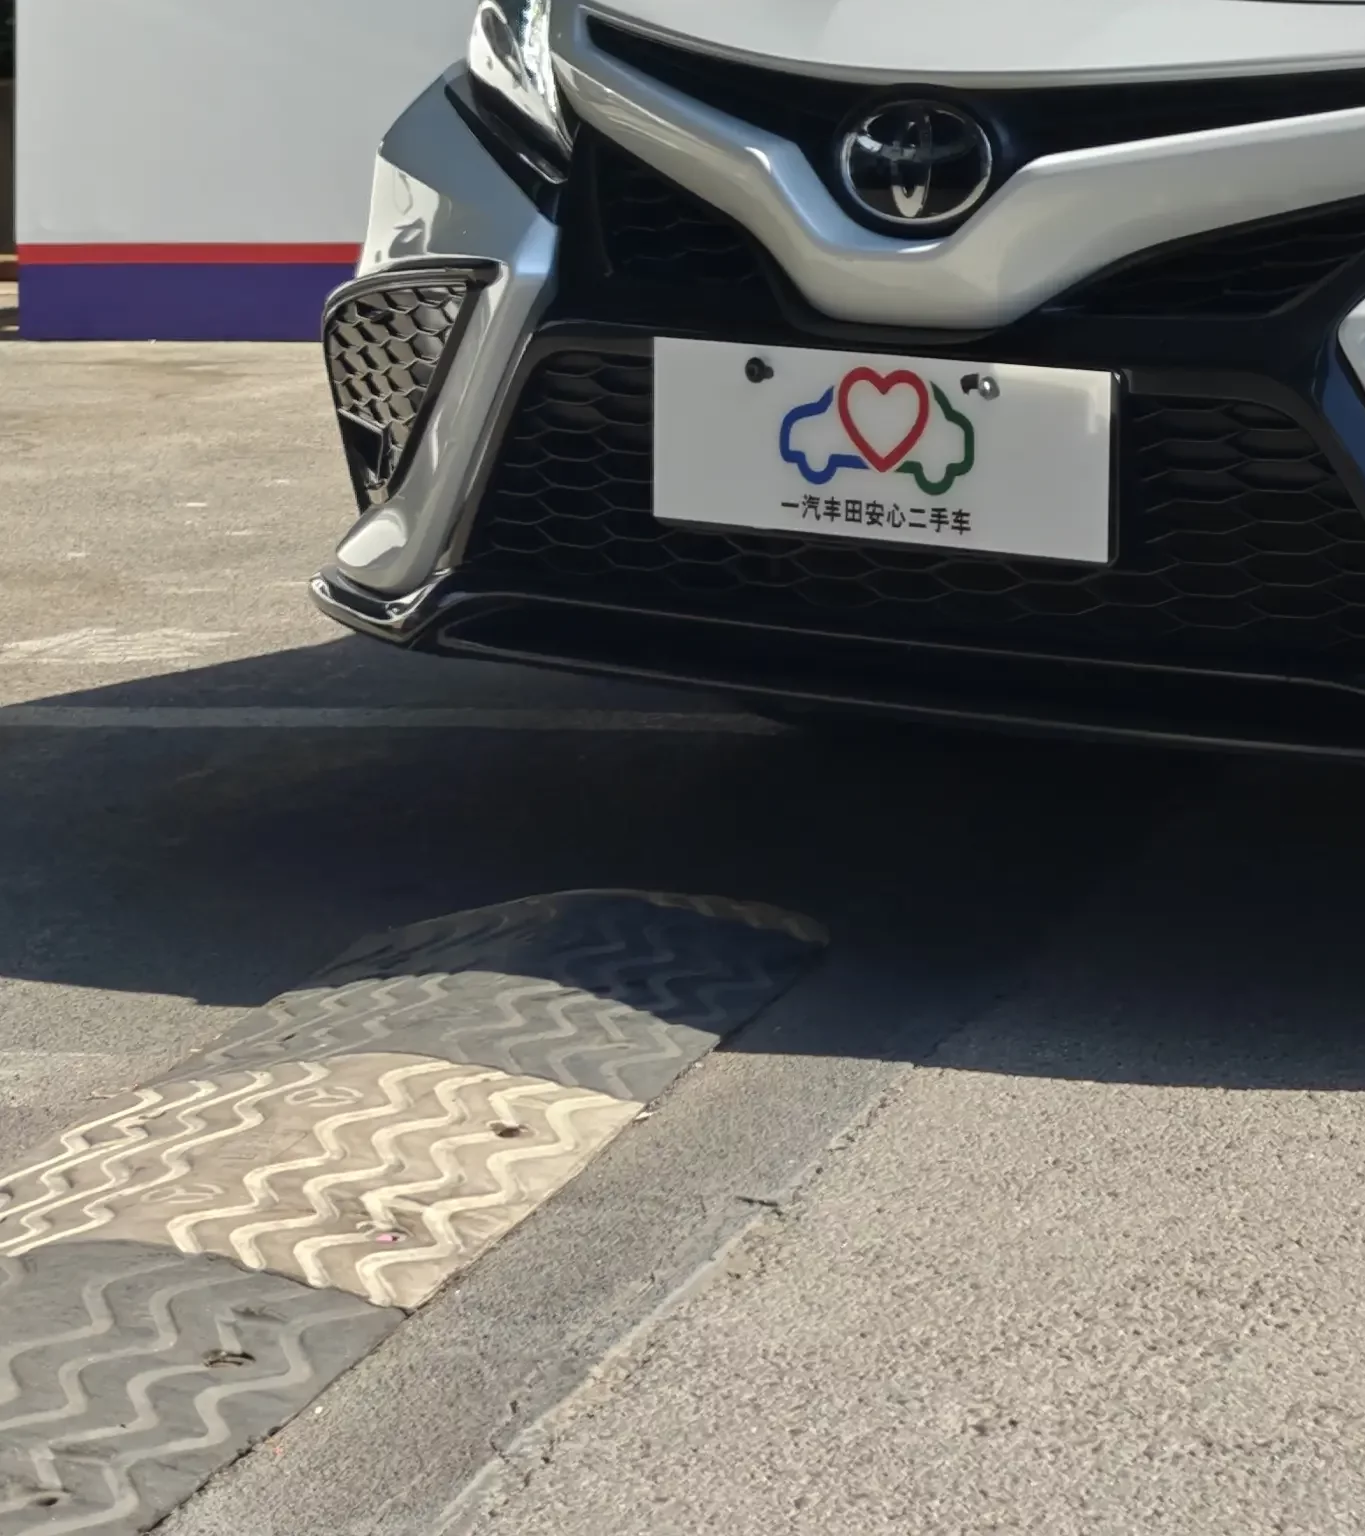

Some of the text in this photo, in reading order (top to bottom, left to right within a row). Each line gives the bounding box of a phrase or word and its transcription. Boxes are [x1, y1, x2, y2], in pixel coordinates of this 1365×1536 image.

[780, 494, 972, 535] 一汽丰田安心二手车
